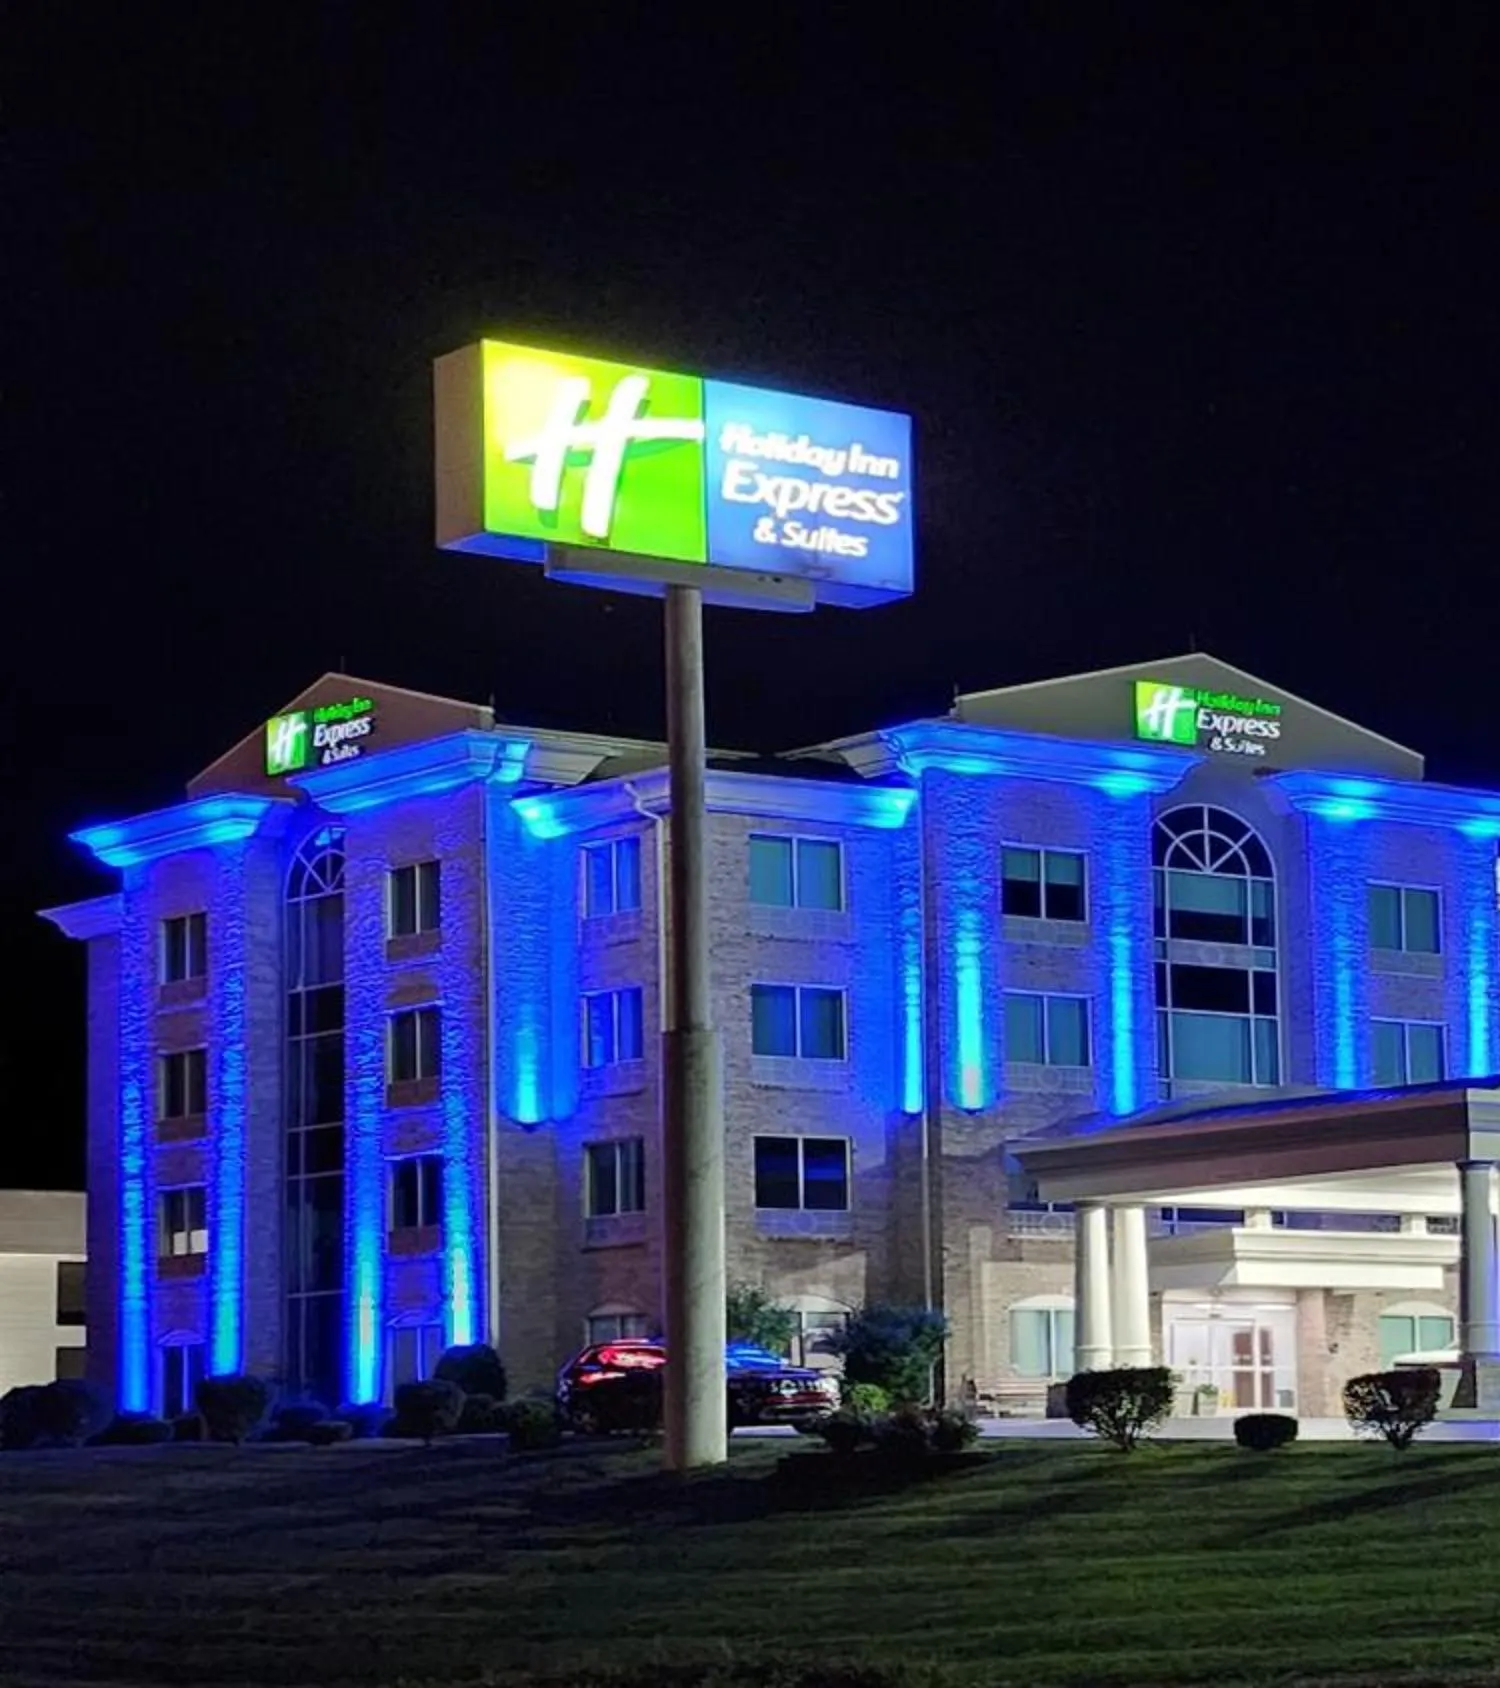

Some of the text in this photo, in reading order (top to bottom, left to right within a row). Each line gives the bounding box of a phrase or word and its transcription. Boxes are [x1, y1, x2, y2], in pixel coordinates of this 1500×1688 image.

[719, 422, 899, 479] Holiday Inn
[722, 459, 903, 525] Express
[754, 517, 868, 557] & Suites
[313, 717, 371, 748] Express
[1197, 708, 1280, 739] Express
[1210, 737, 1222, 751] &
